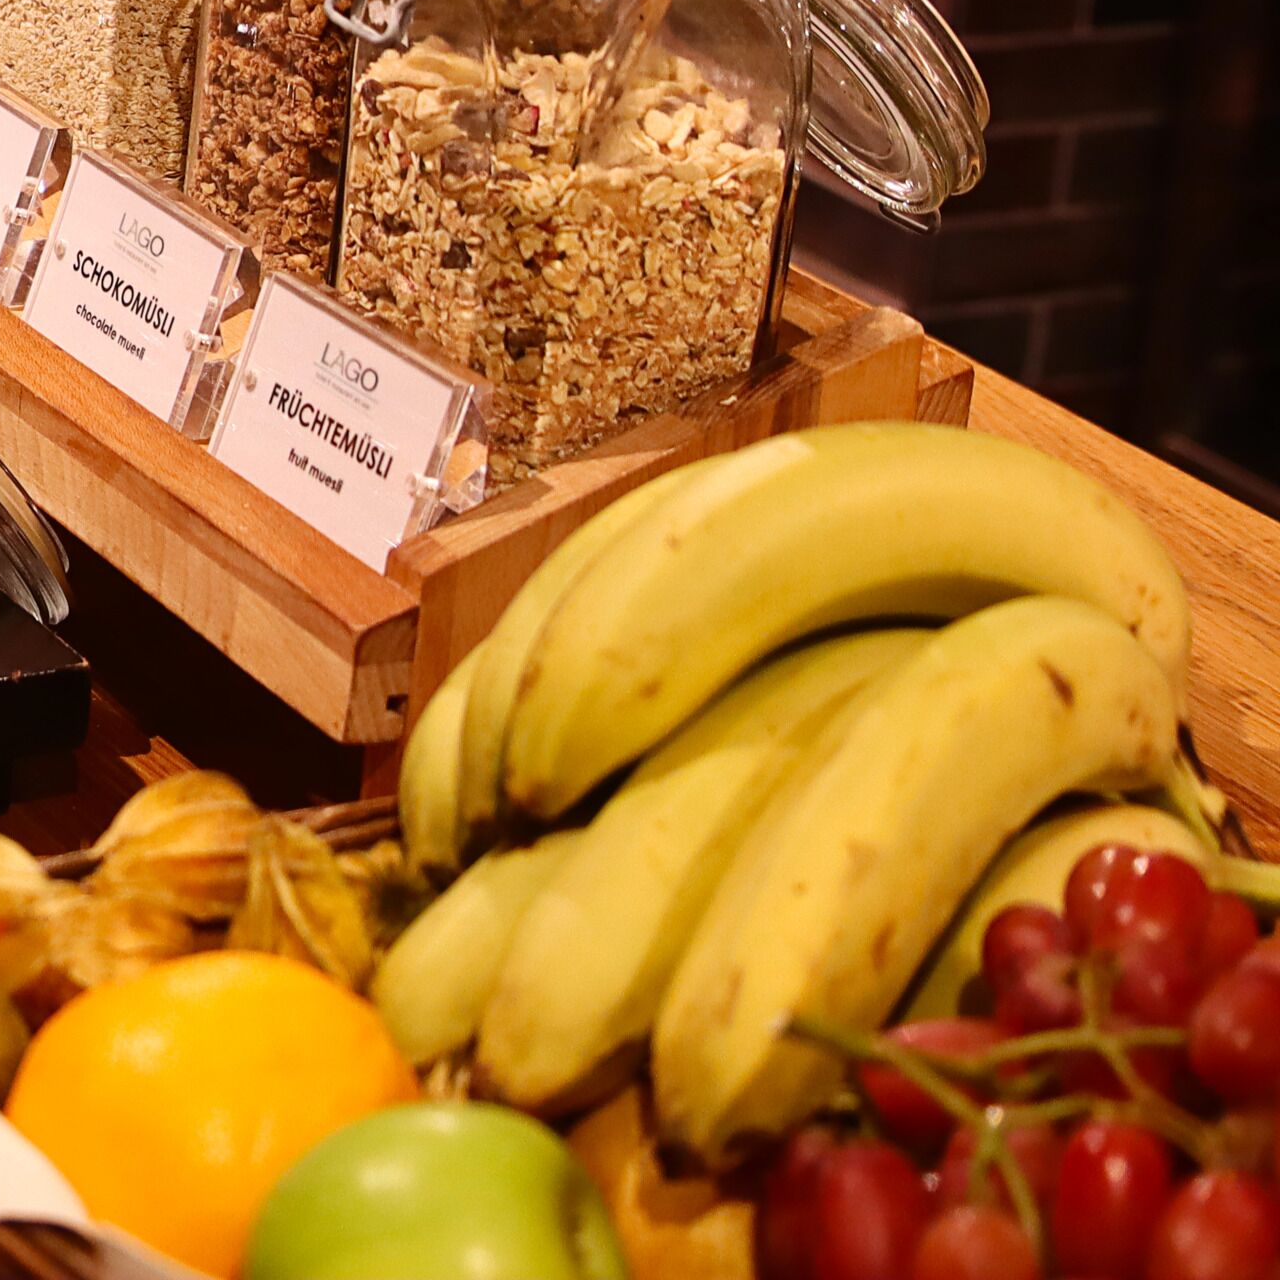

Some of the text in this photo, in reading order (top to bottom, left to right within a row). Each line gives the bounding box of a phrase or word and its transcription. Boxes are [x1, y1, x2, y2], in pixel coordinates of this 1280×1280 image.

[119, 212, 165, 258] LAGO
[73, 250, 176, 338] SCHOKOMÜSLI
[76, 303, 146, 360] chocolate muesli
[320, 342, 380, 392] LAGO
[269, 383, 393, 479] FRÜCHTEMÜSLI
[288, 448, 344, 494] fruit muesli
